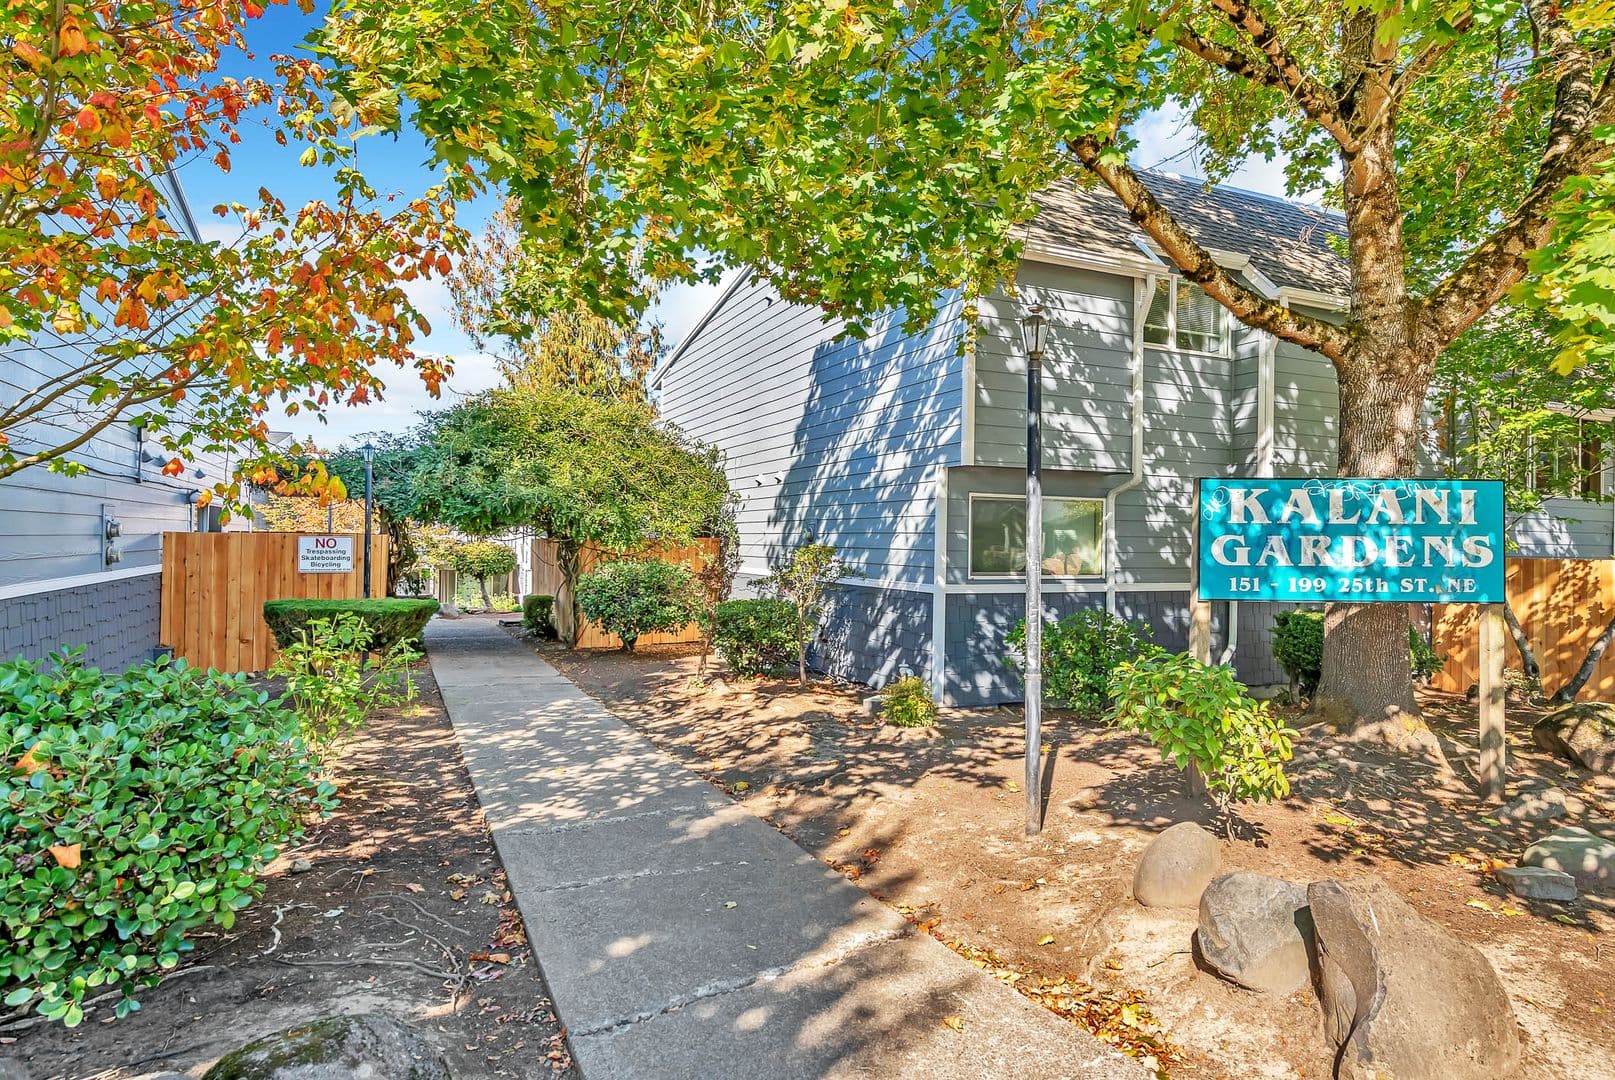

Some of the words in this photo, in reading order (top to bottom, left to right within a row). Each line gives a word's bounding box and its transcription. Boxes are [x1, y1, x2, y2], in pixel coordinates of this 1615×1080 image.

[1227, 488, 1478, 525] KALANI
[315, 538, 337, 548] NO
[1210, 534, 1495, 568] GARDENS
[1229, 577, 1260, 592] 151
[1288, 577, 1327, 593] 199
[1338, 577, 1389, 593] 25th
[1400, 578, 1435, 593] ST.
[1446, 578, 1477, 593] NE
